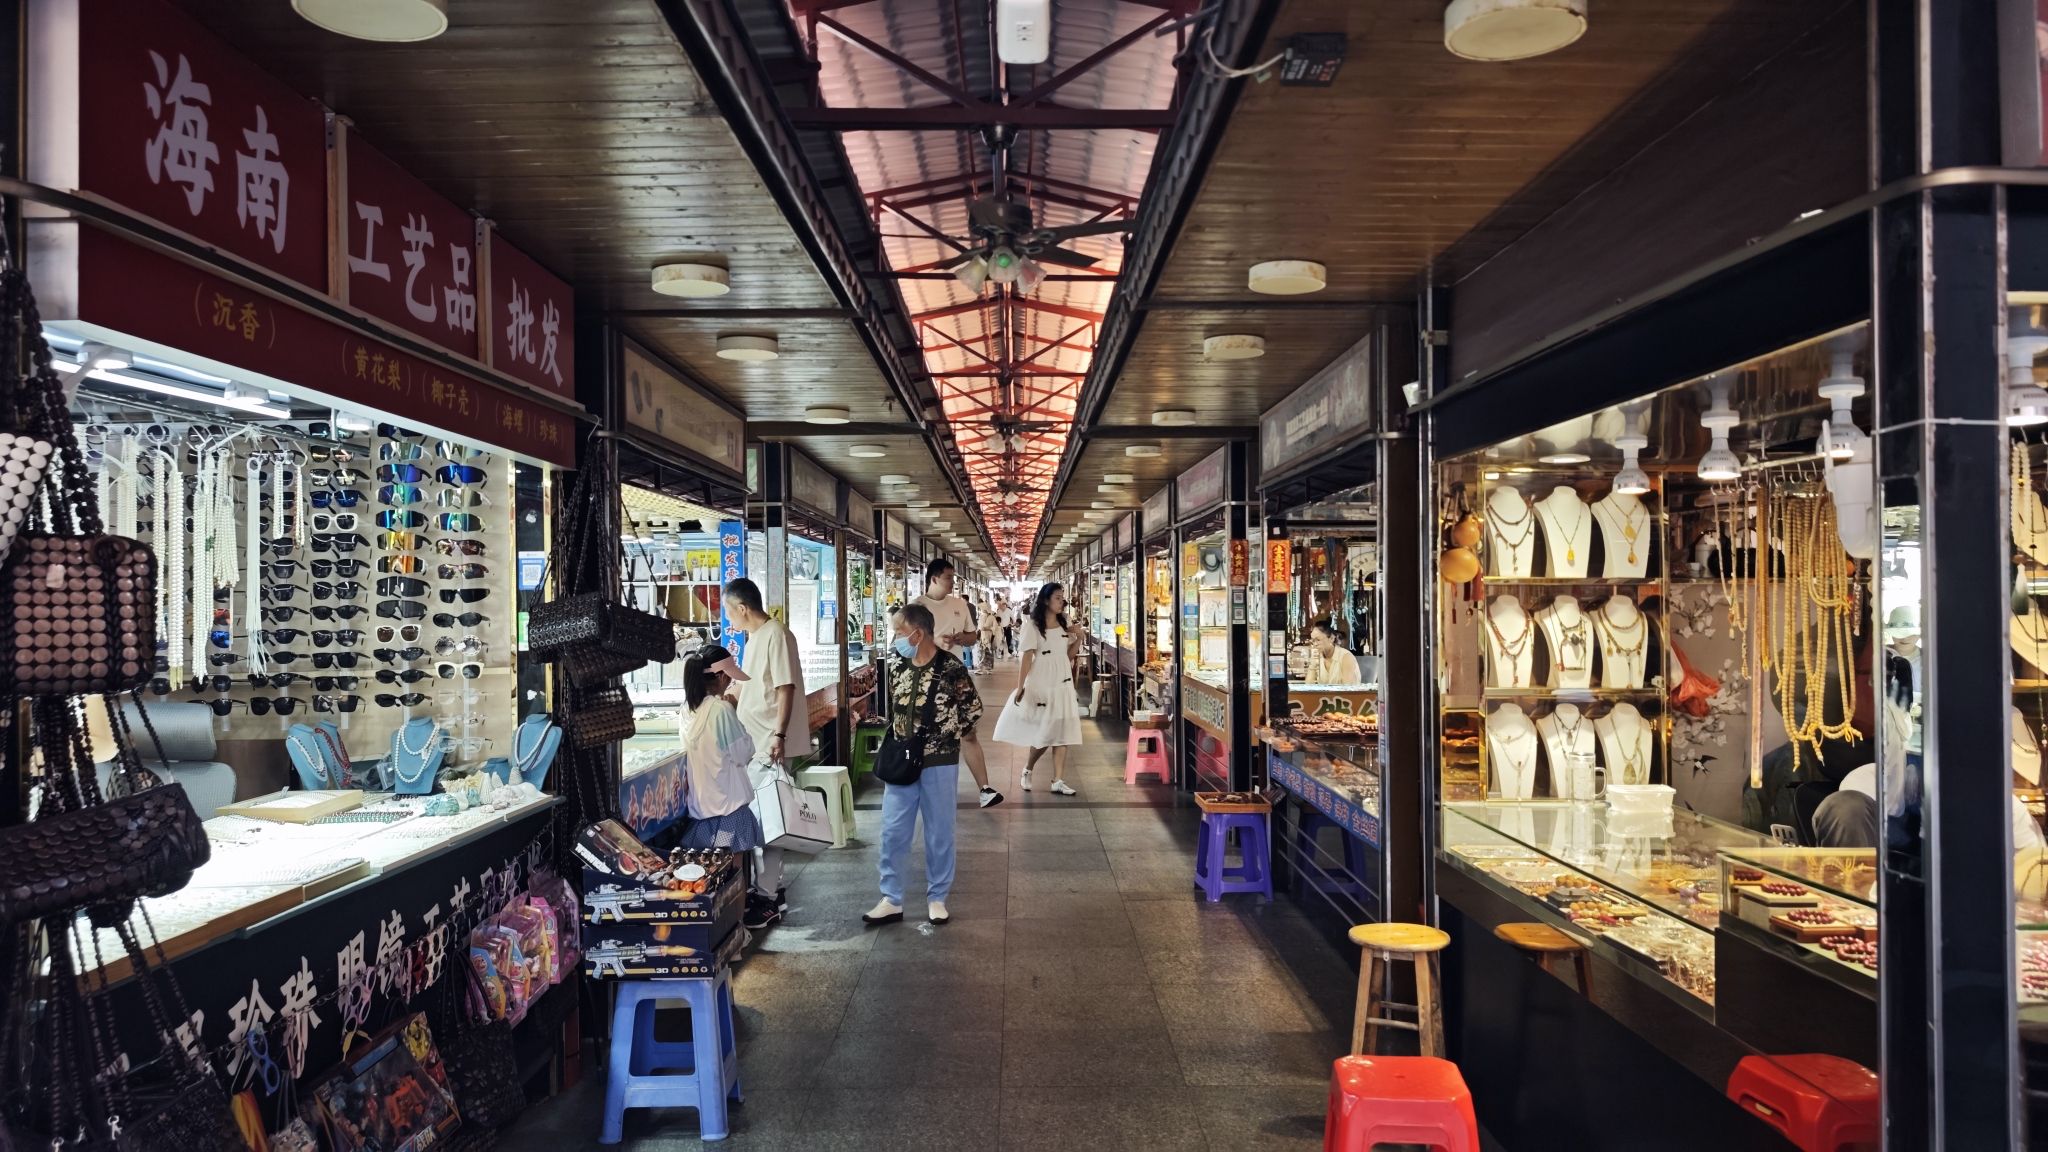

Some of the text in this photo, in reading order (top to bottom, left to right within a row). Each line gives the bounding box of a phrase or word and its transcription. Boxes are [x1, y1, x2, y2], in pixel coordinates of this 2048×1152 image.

[143, 49, 563, 387] 海南 工艺品 批发
